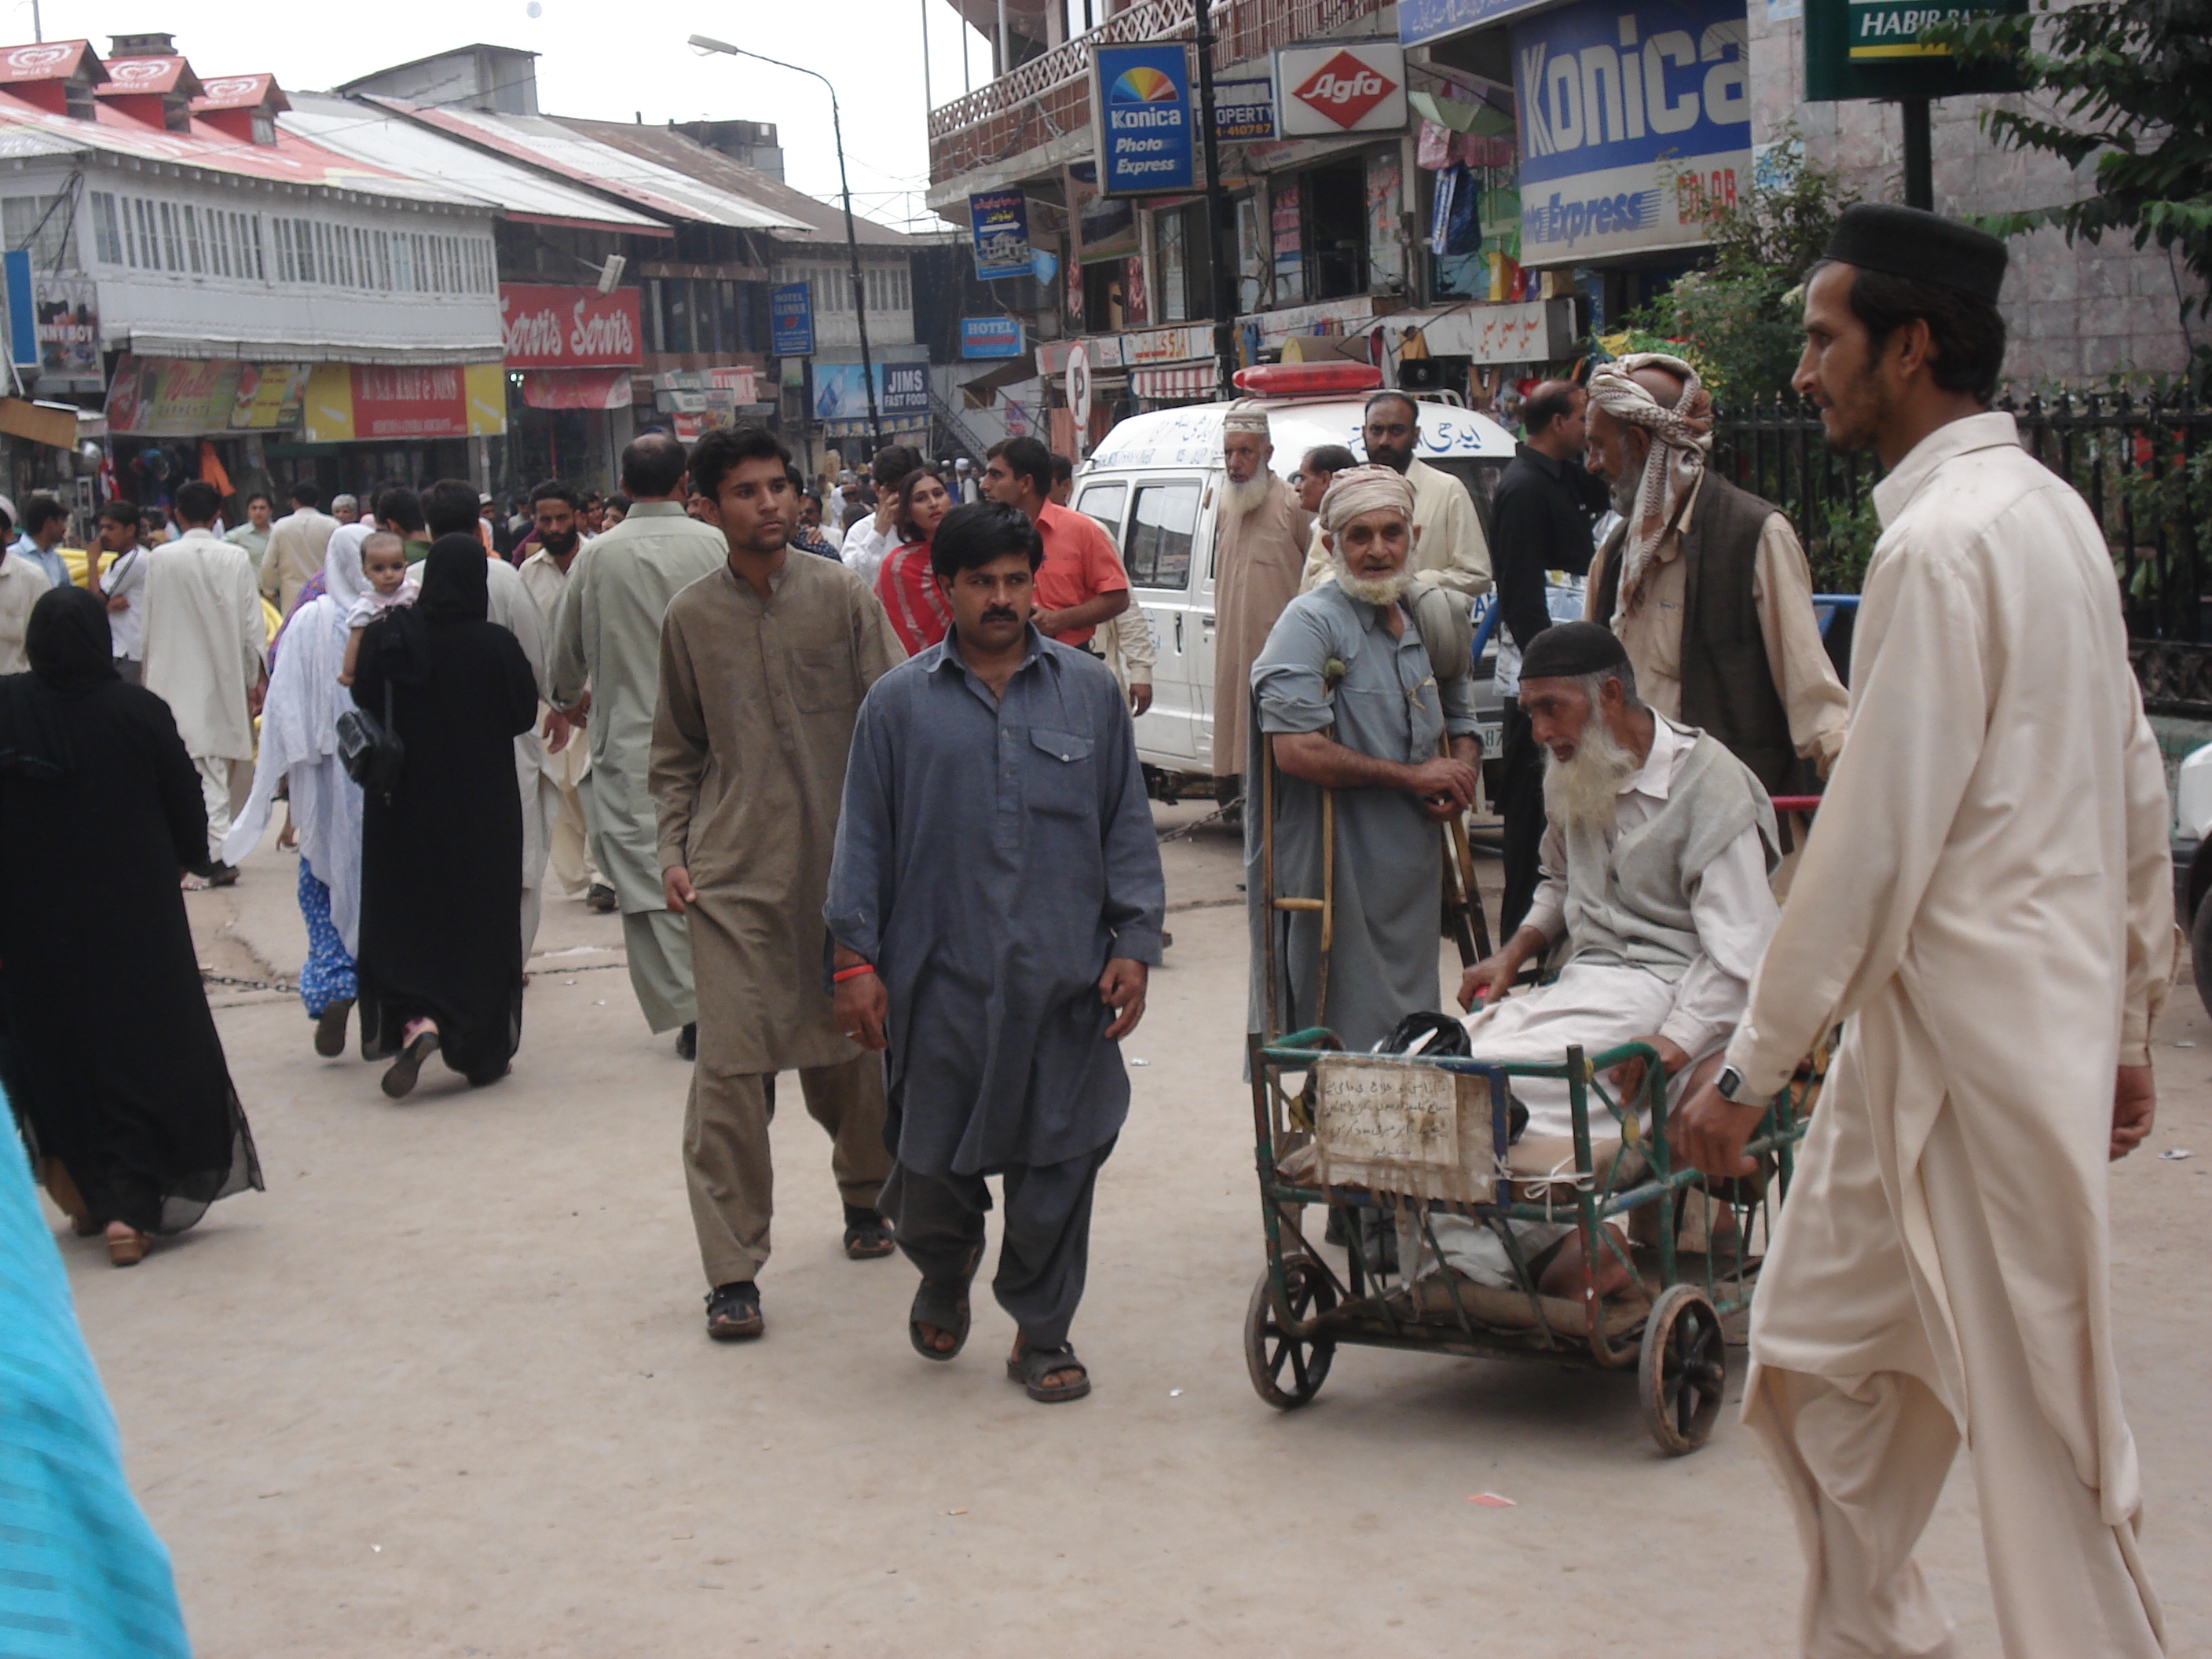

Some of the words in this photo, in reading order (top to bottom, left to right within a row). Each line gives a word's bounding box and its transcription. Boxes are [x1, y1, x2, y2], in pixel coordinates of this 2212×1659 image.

[1860, 9, 1942, 38] HABIB
[1302, 70, 1382, 104] Agfa
[1521, 13, 1751, 159] Konica
[1111, 106, 1181, 130] Konica
[1115, 137, 1163, 154] Photo
[1116, 158, 1176, 176] Express
[1548, 191, 1646, 248] Express
[967, 320, 1015, 335] HOTEL
[887, 368, 924, 394] JIMS
[884, 394, 904, 408] FAST
[905, 393, 928, 406] FOOD
